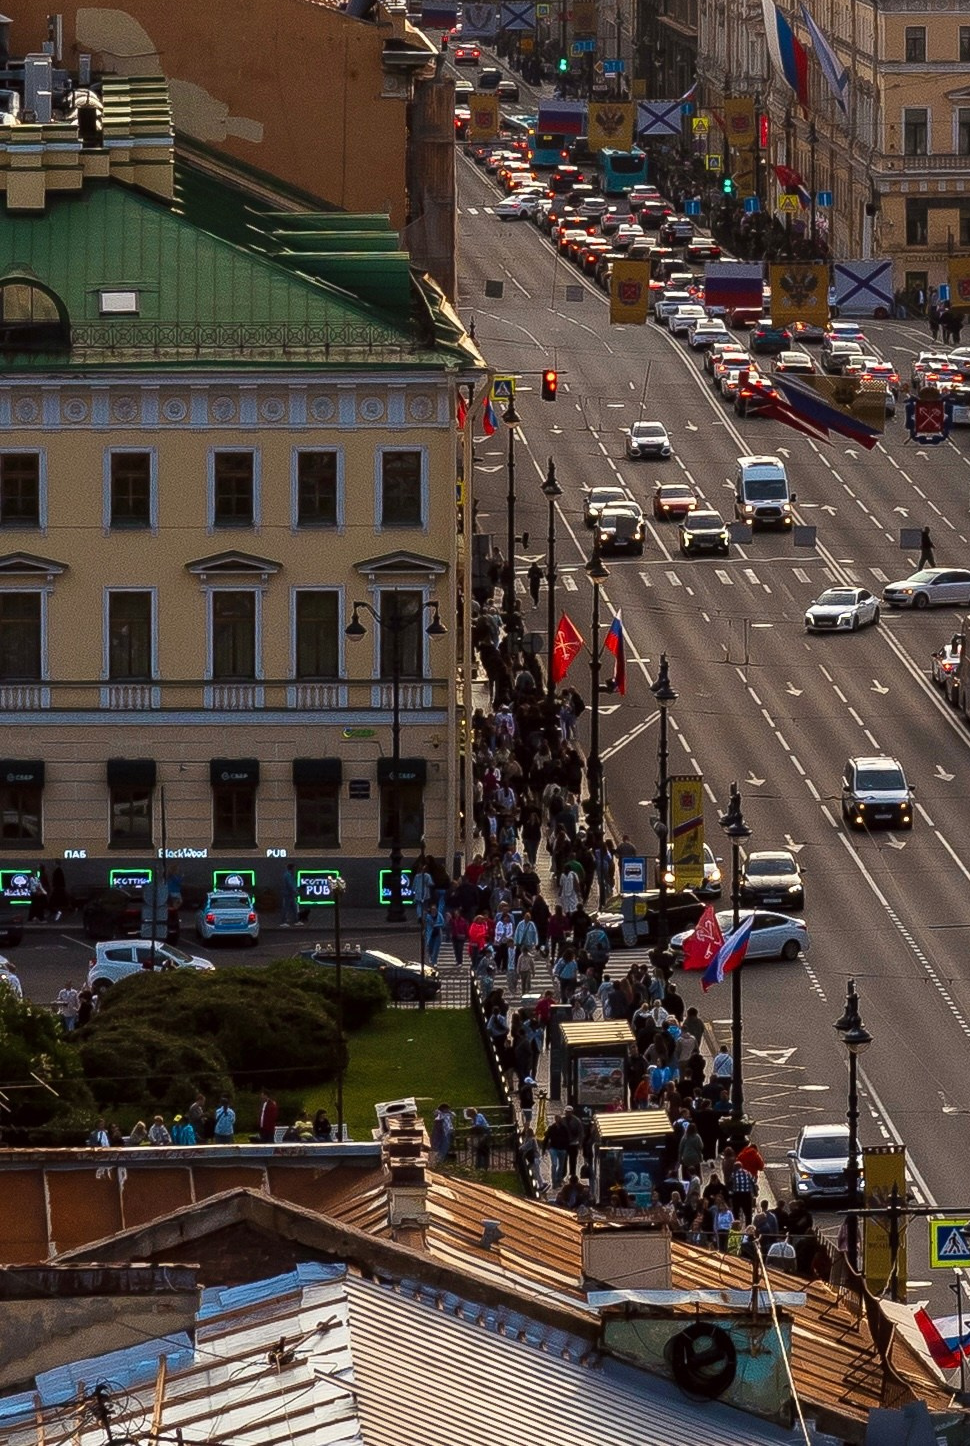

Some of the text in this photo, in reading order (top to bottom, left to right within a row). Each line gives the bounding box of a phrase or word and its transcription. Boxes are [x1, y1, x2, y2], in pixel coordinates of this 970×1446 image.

[64, 847, 287, 859] ПАБ BlackWood PUB
[306, 885, 331, 895] PUB
